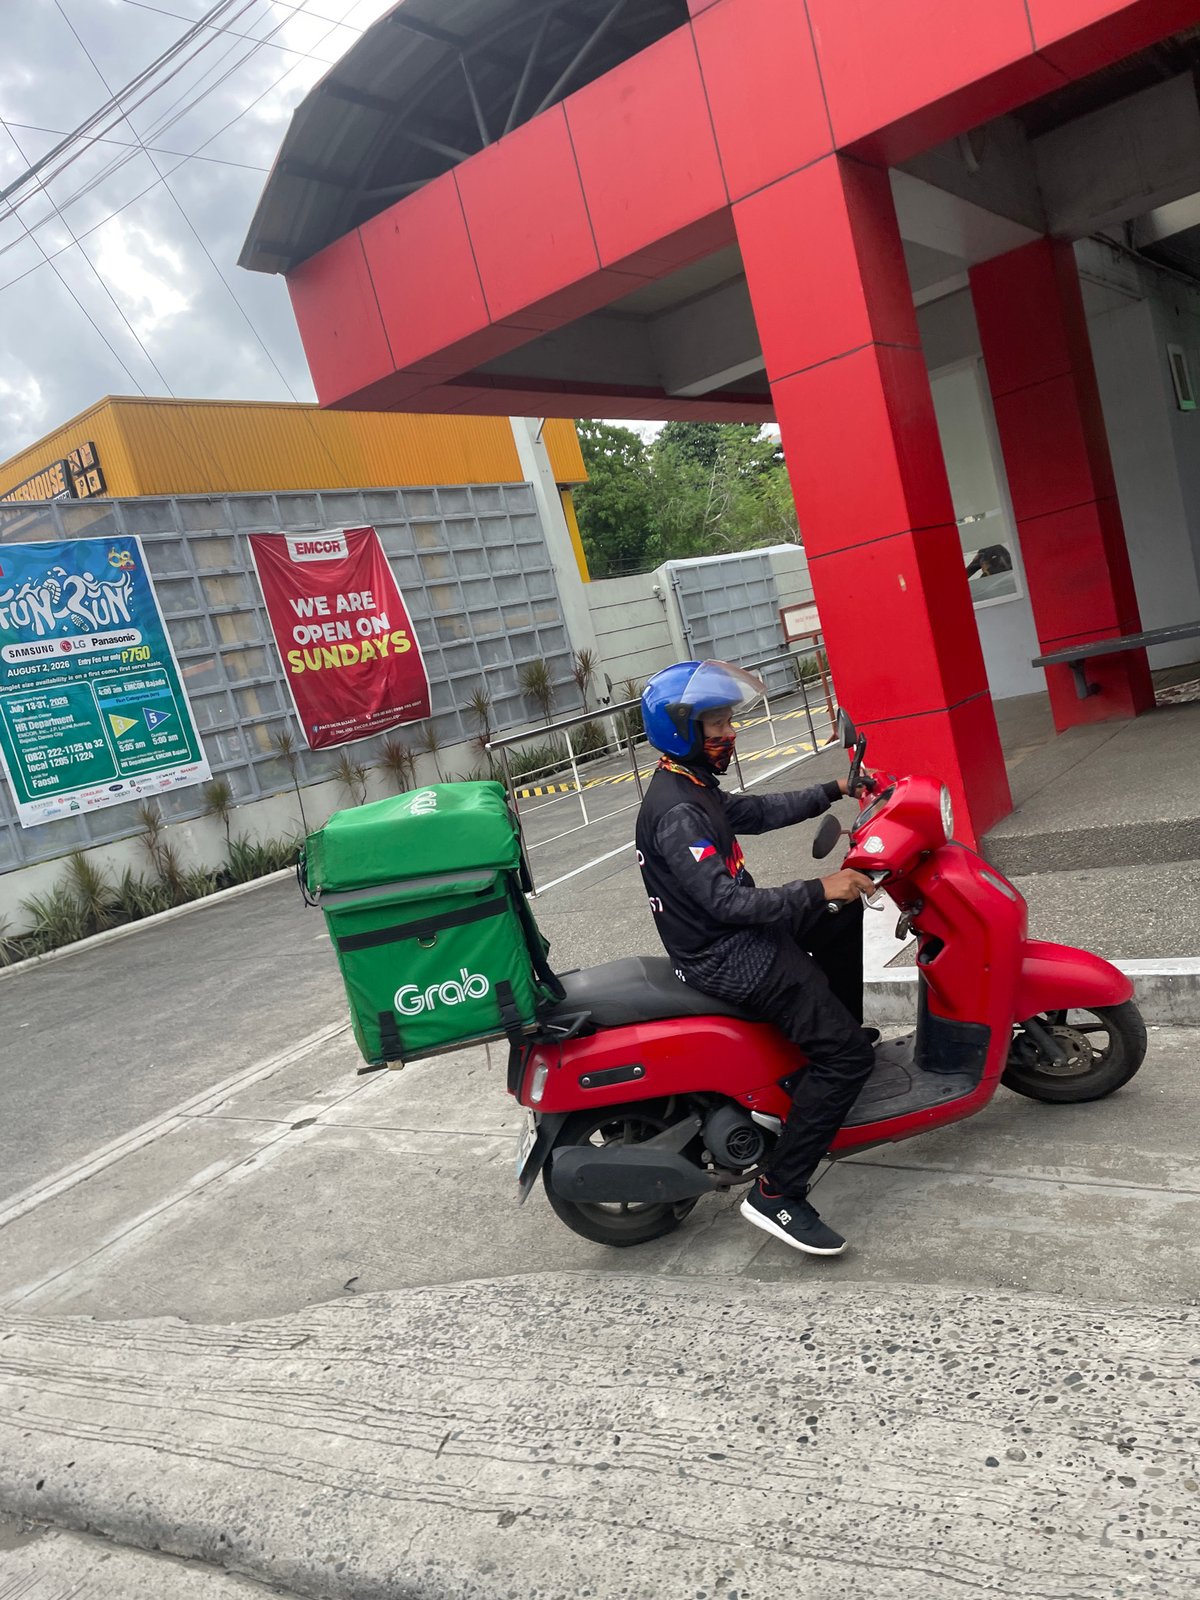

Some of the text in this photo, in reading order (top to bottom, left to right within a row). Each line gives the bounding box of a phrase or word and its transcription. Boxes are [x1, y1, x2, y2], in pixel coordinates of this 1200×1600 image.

[294, 540, 341, 555] EMCOR
[289, 590, 377, 618] WE ARE
[293, 612, 391, 645] OPEN ON
[9, 633, 136, 658] SAMSUNG LG Panasonic
[287, 630, 411, 674] SUNDAYS
[77, 658, 91, 666] Entry
[92, 656, 102, 664] Fee
[102, 654, 110, 662] for
[121, 645, 151, 663] P750
[7, 660, 70, 677] AUGUST 2, 2026
[35, 676, 67, 686] availability
[112, 685, 123, 693] am
[9, 704, 25, 714] July
[149, 712, 158, 724] 5
[15, 714, 74, 733] HR Department
[117, 719, 125, 730] 3
[135, 741, 146, 749] am
[168, 734, 179, 742] am
[25, 739, 104, 763] (082) 222-1125 to 32
[27, 761, 48, 772] local
[74, 752, 94, 762] 1224
[394, 968, 489, 1016] Grab
